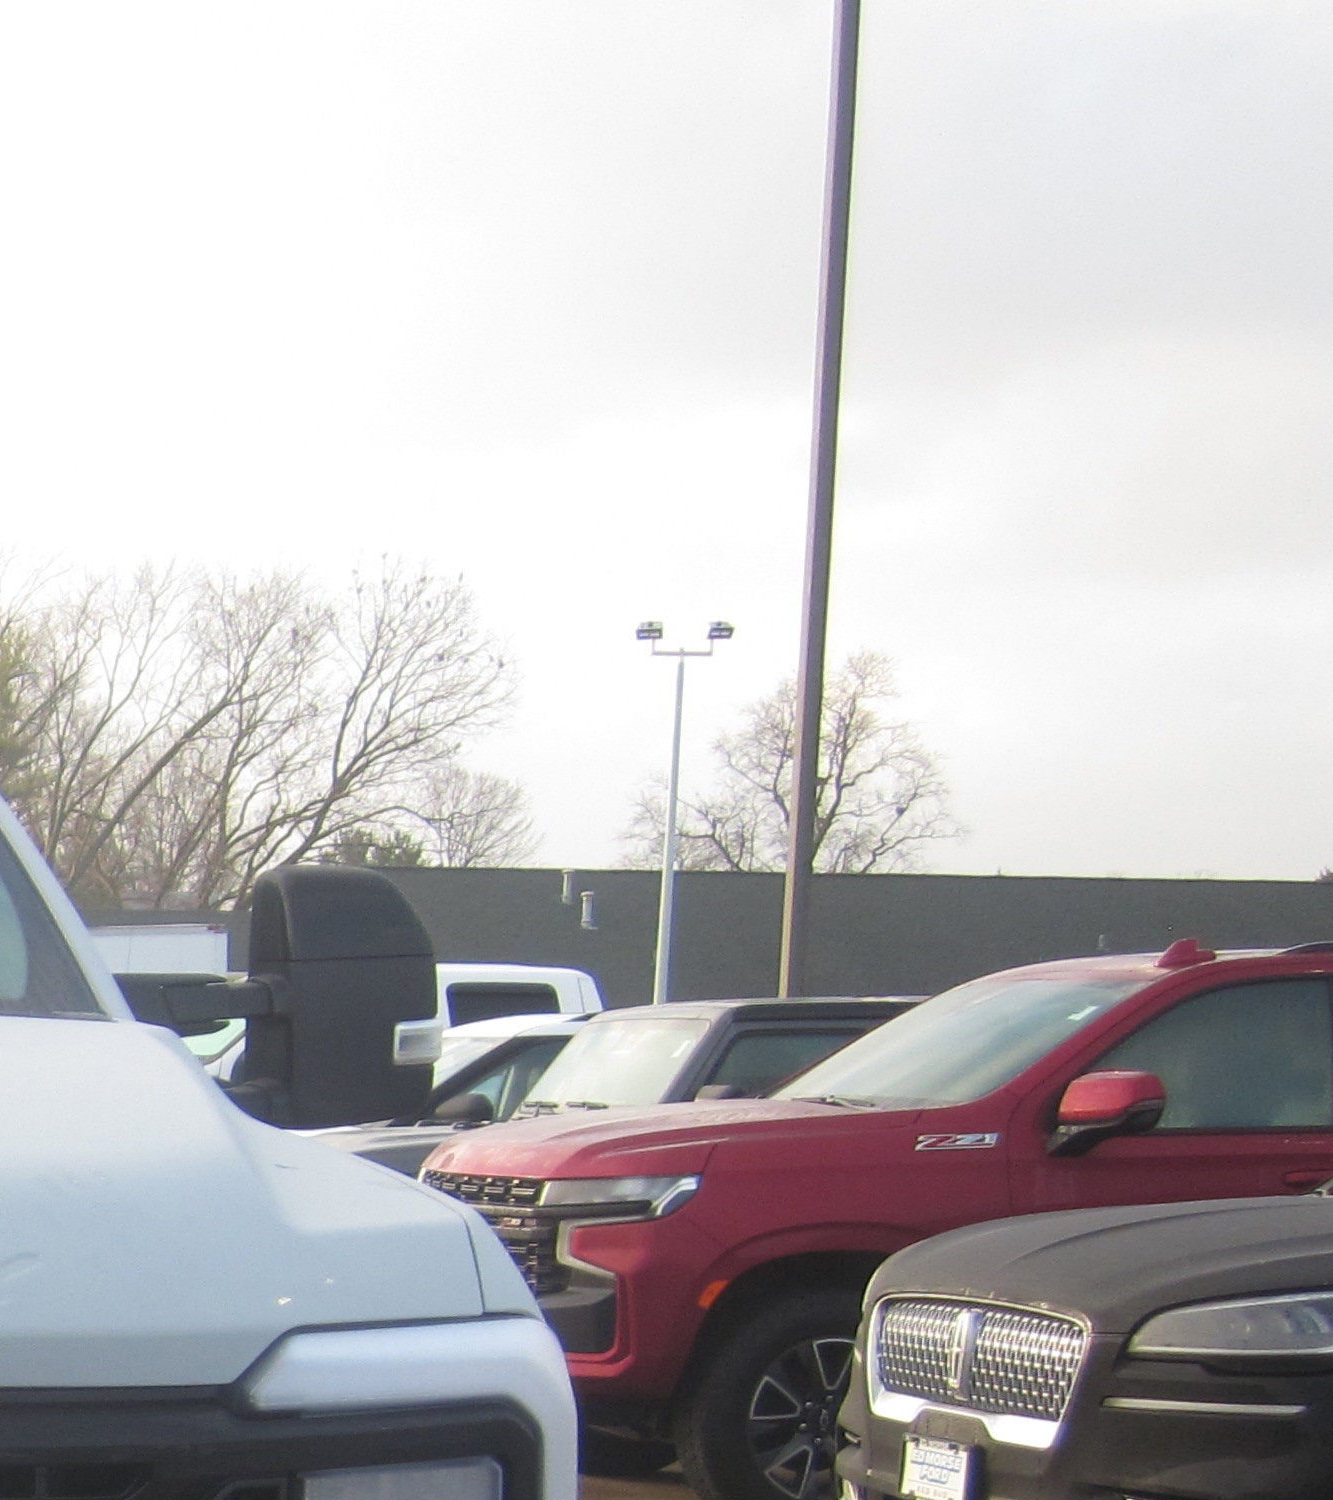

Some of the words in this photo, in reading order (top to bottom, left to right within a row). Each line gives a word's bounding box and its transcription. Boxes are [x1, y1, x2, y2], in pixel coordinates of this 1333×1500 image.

[915, 1132, 1000, 1151] Z71
[924, 1450, 963, 1473] MORSE
[919, 1465, 950, 1485] FORD
